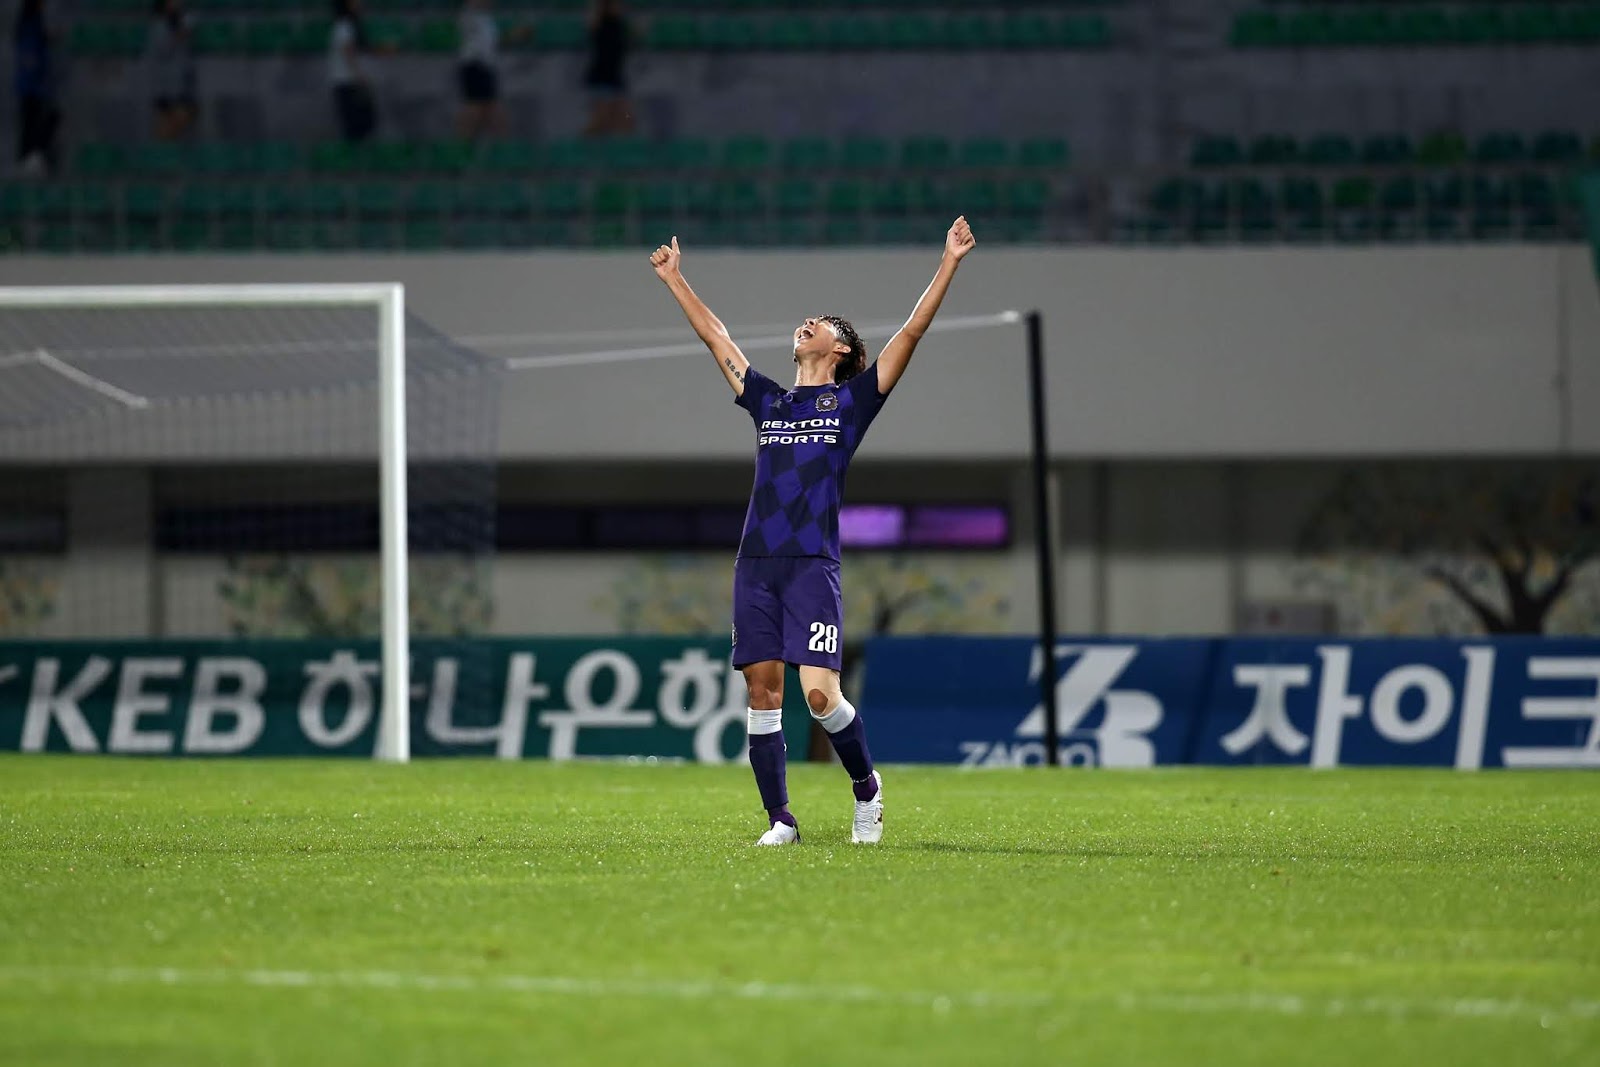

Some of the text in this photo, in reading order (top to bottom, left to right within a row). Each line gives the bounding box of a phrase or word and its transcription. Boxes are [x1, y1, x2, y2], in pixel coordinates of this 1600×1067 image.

[761, 418, 840, 430] REXTON
[759, 434, 837, 446] SPORTS
[808, 621, 839, 654] 28
[20, 655, 267, 754] KEB
